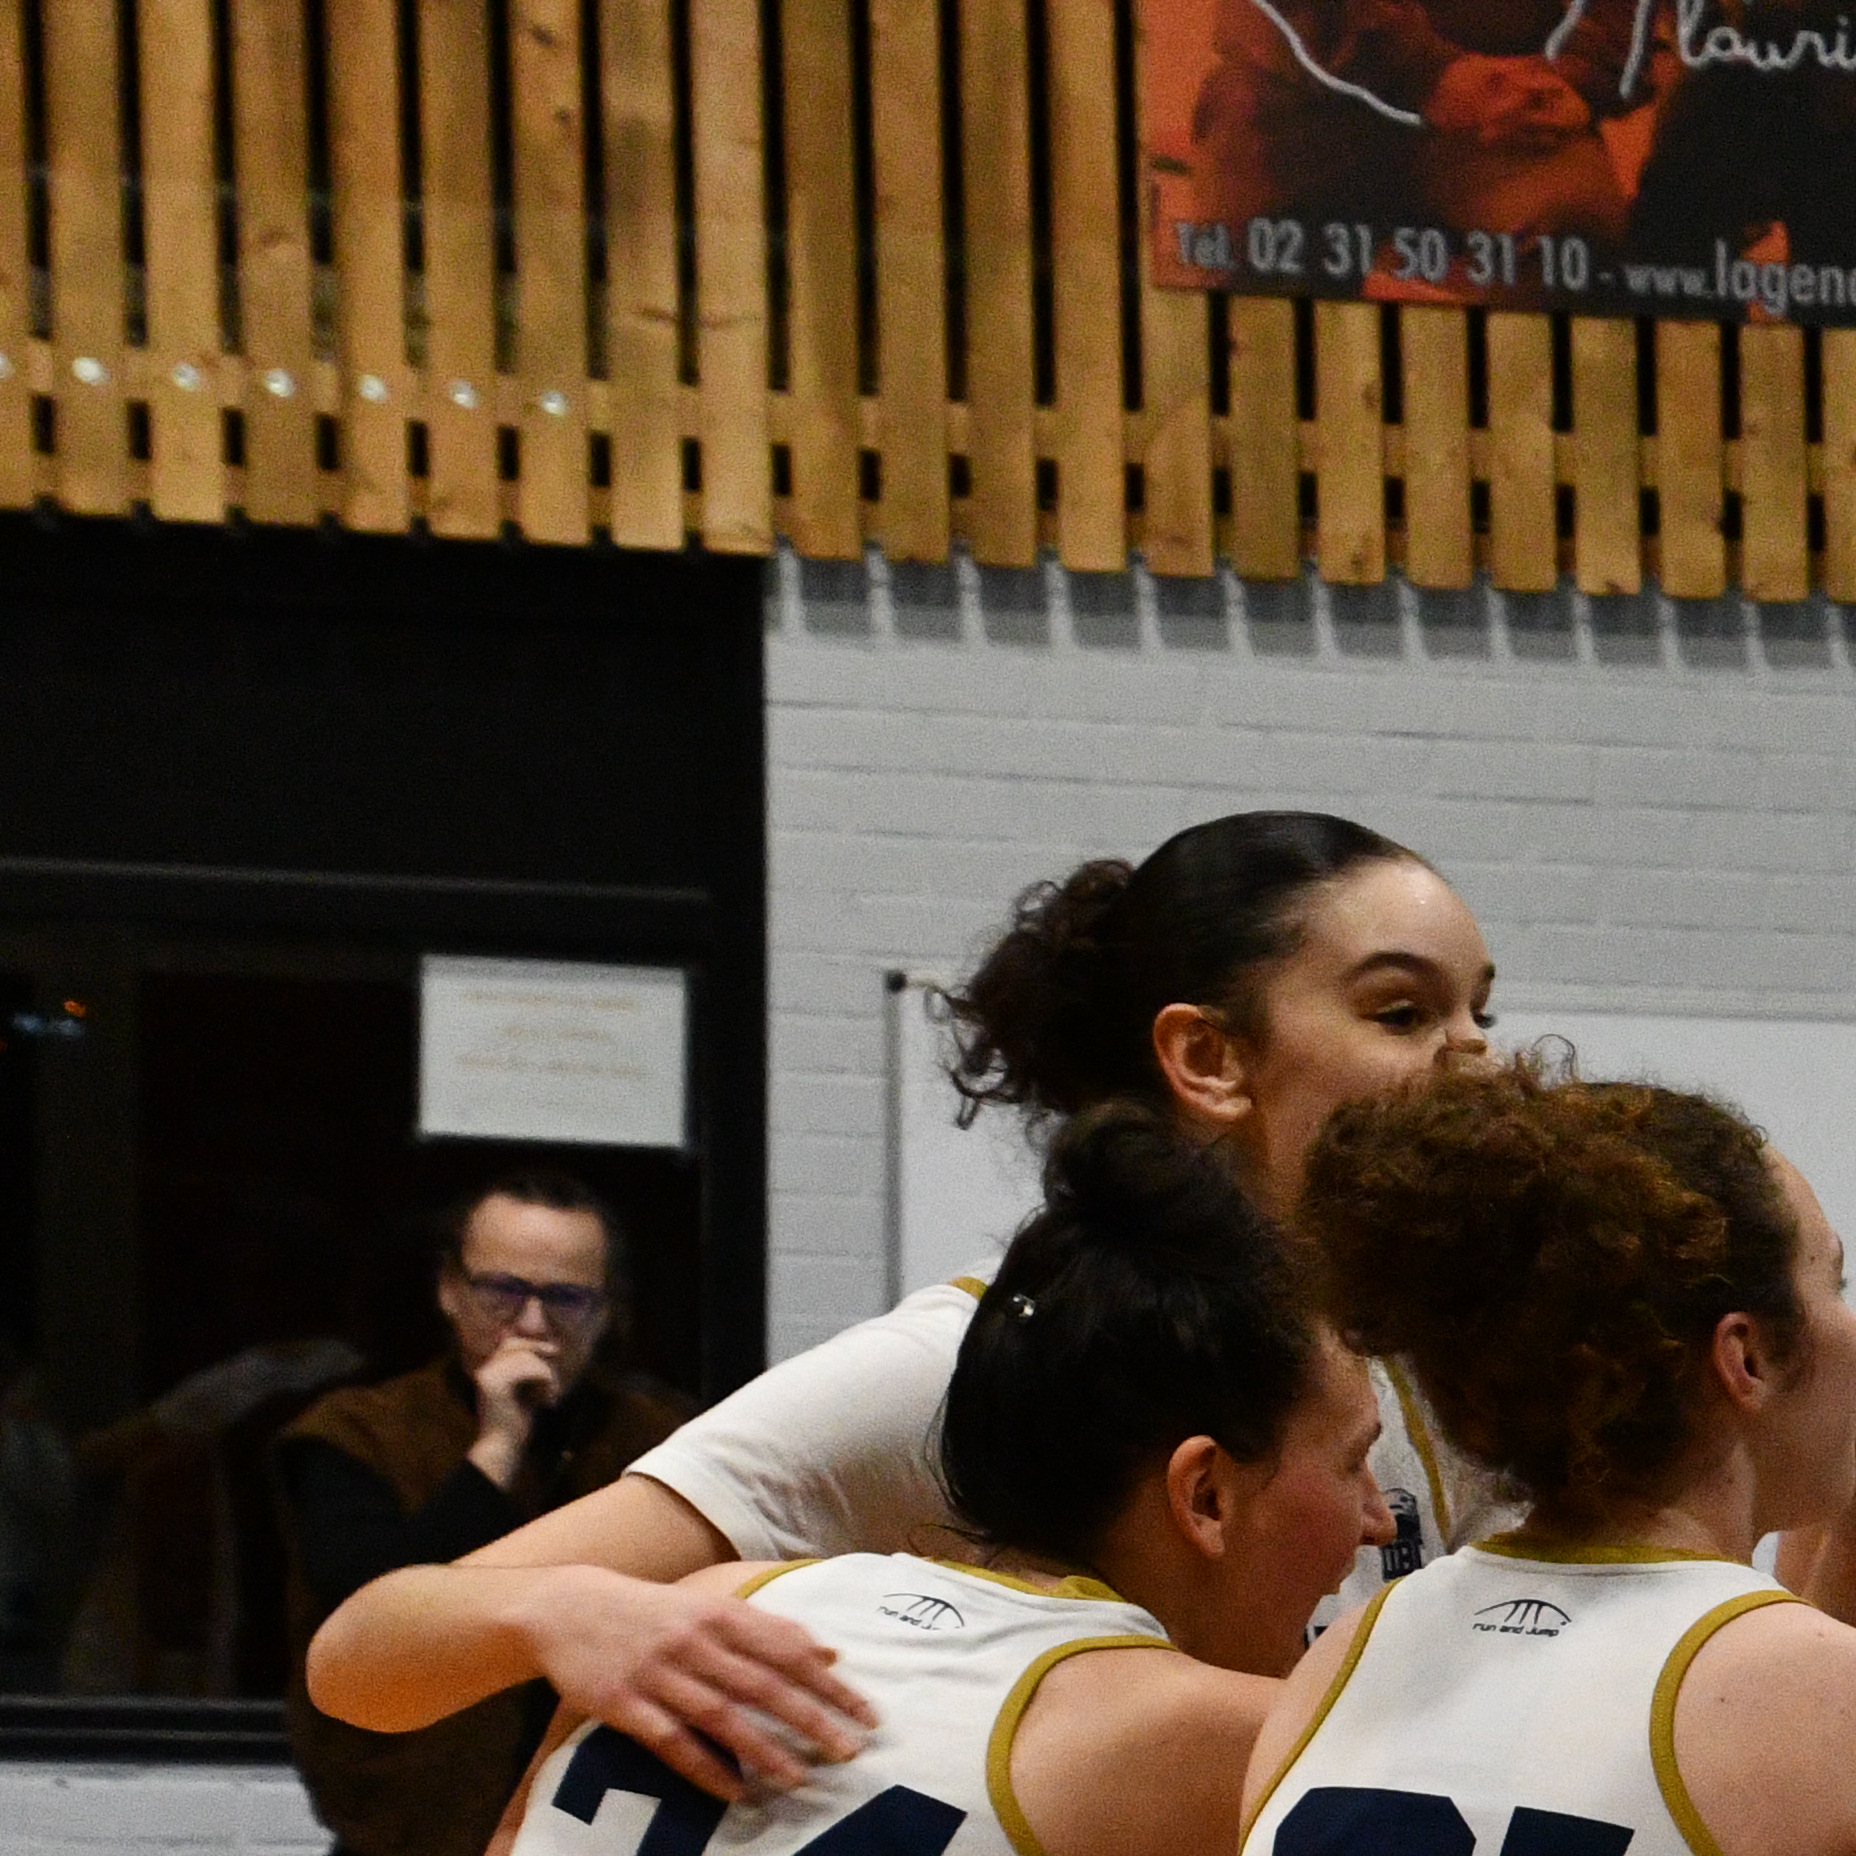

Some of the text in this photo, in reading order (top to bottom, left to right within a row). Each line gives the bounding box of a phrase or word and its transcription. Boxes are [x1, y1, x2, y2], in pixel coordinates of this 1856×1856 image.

[1247, 217, 1303, 275] 02
[1322, 222, 1374, 277] 31
[1392, 227, 1449, 282] 50
[1465, 230, 1516, 286] 31
[1536, 234, 1590, 292] 10
